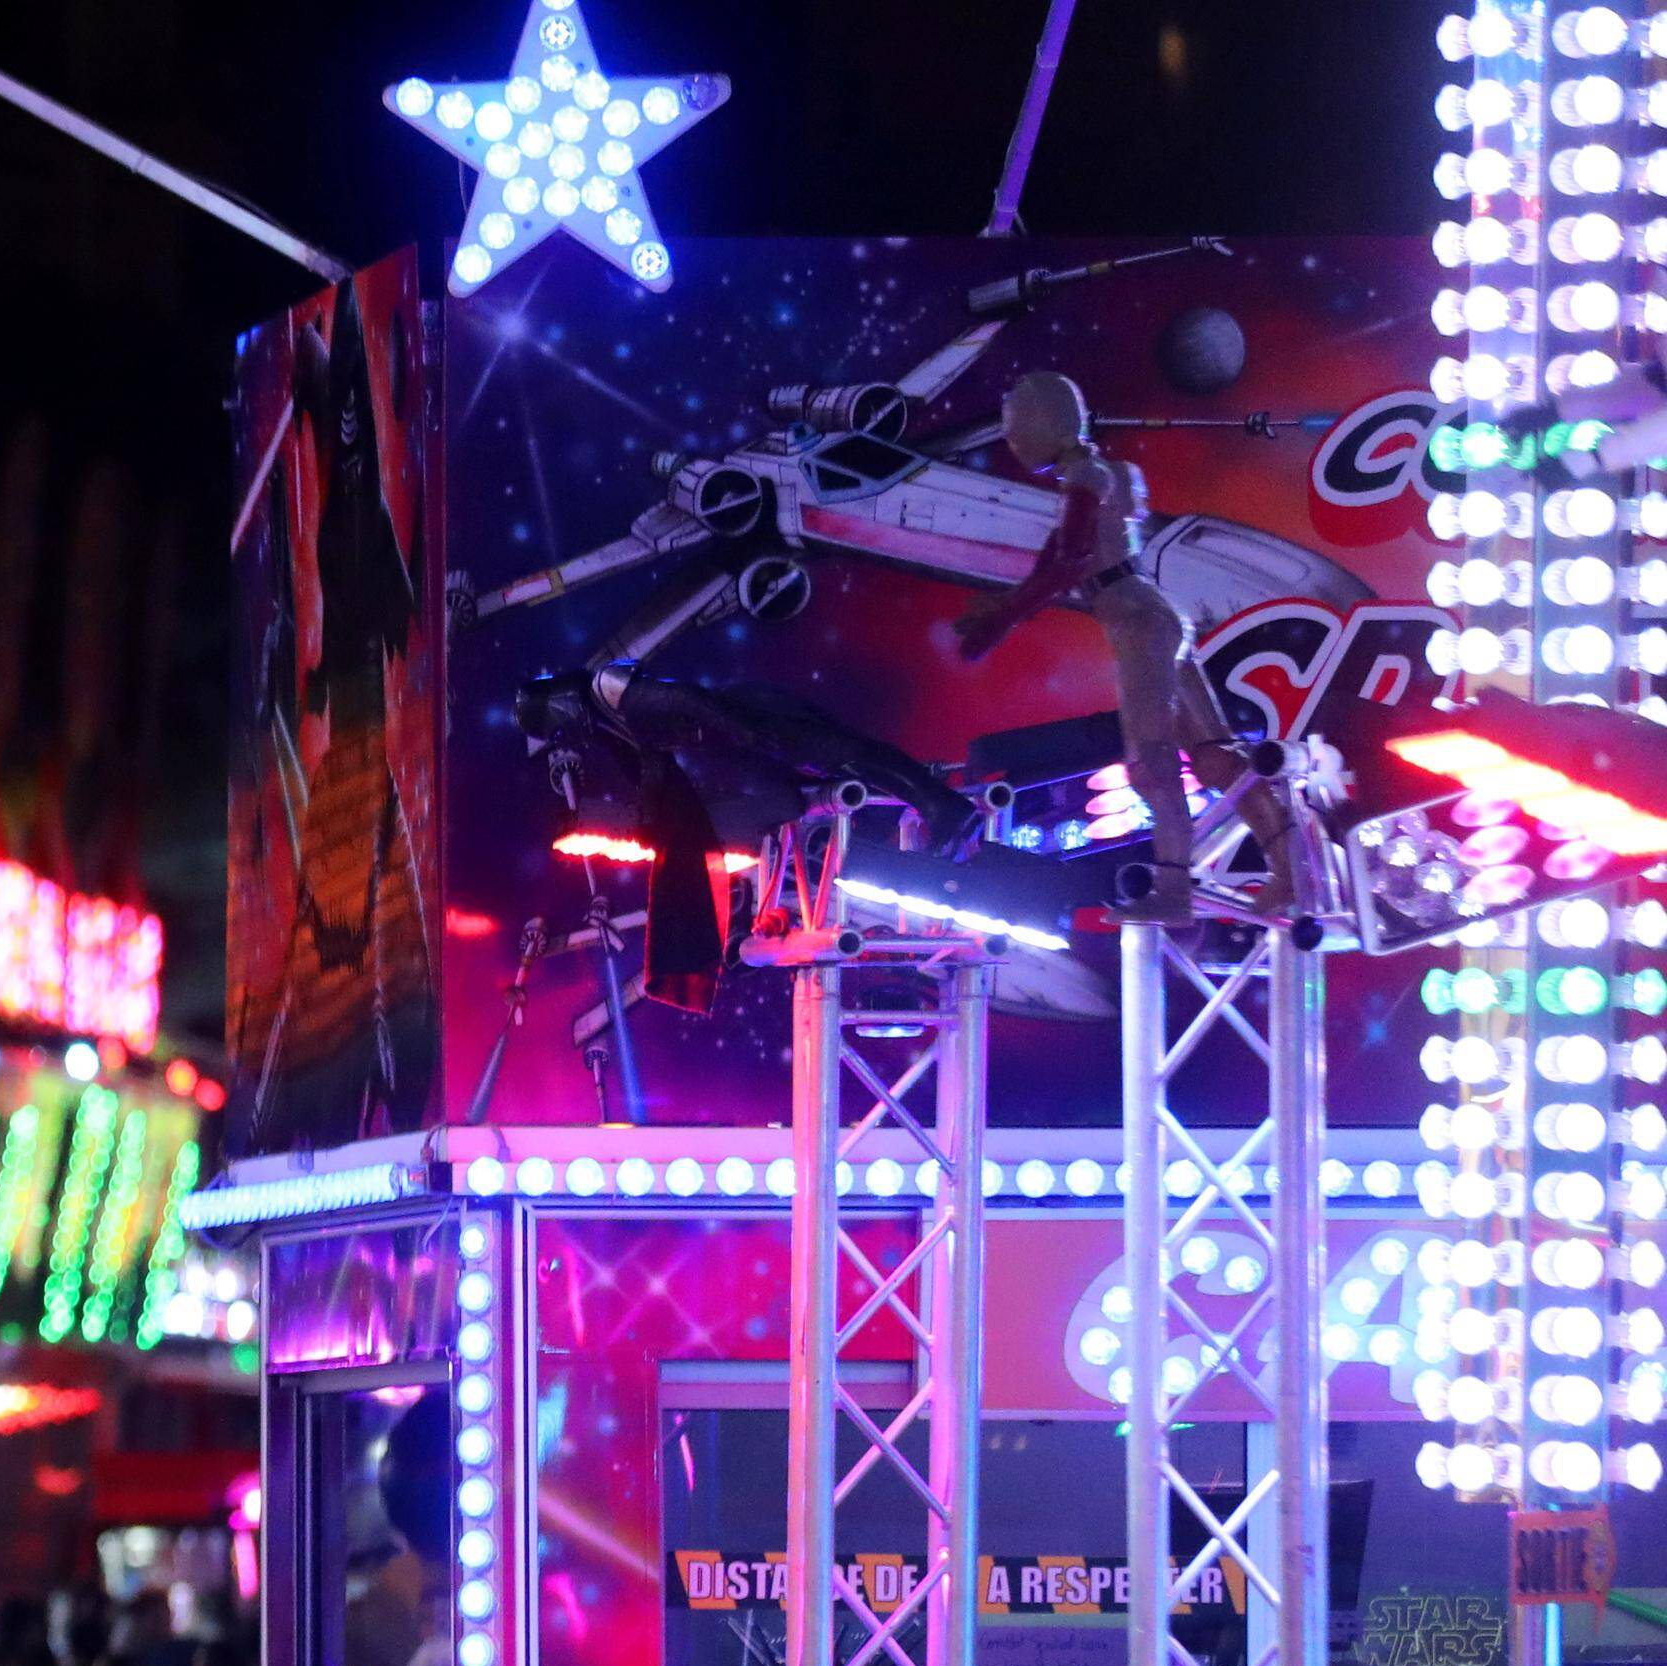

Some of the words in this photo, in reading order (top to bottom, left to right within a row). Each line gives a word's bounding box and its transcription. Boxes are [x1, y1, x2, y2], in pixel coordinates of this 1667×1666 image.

[688, 1560, 864, 1601] DISTAE
[1020, 1566, 1223, 1604] RESPEER
[1364, 1596, 1503, 1632] STAR
[1354, 1633, 1503, 1666] WARS
